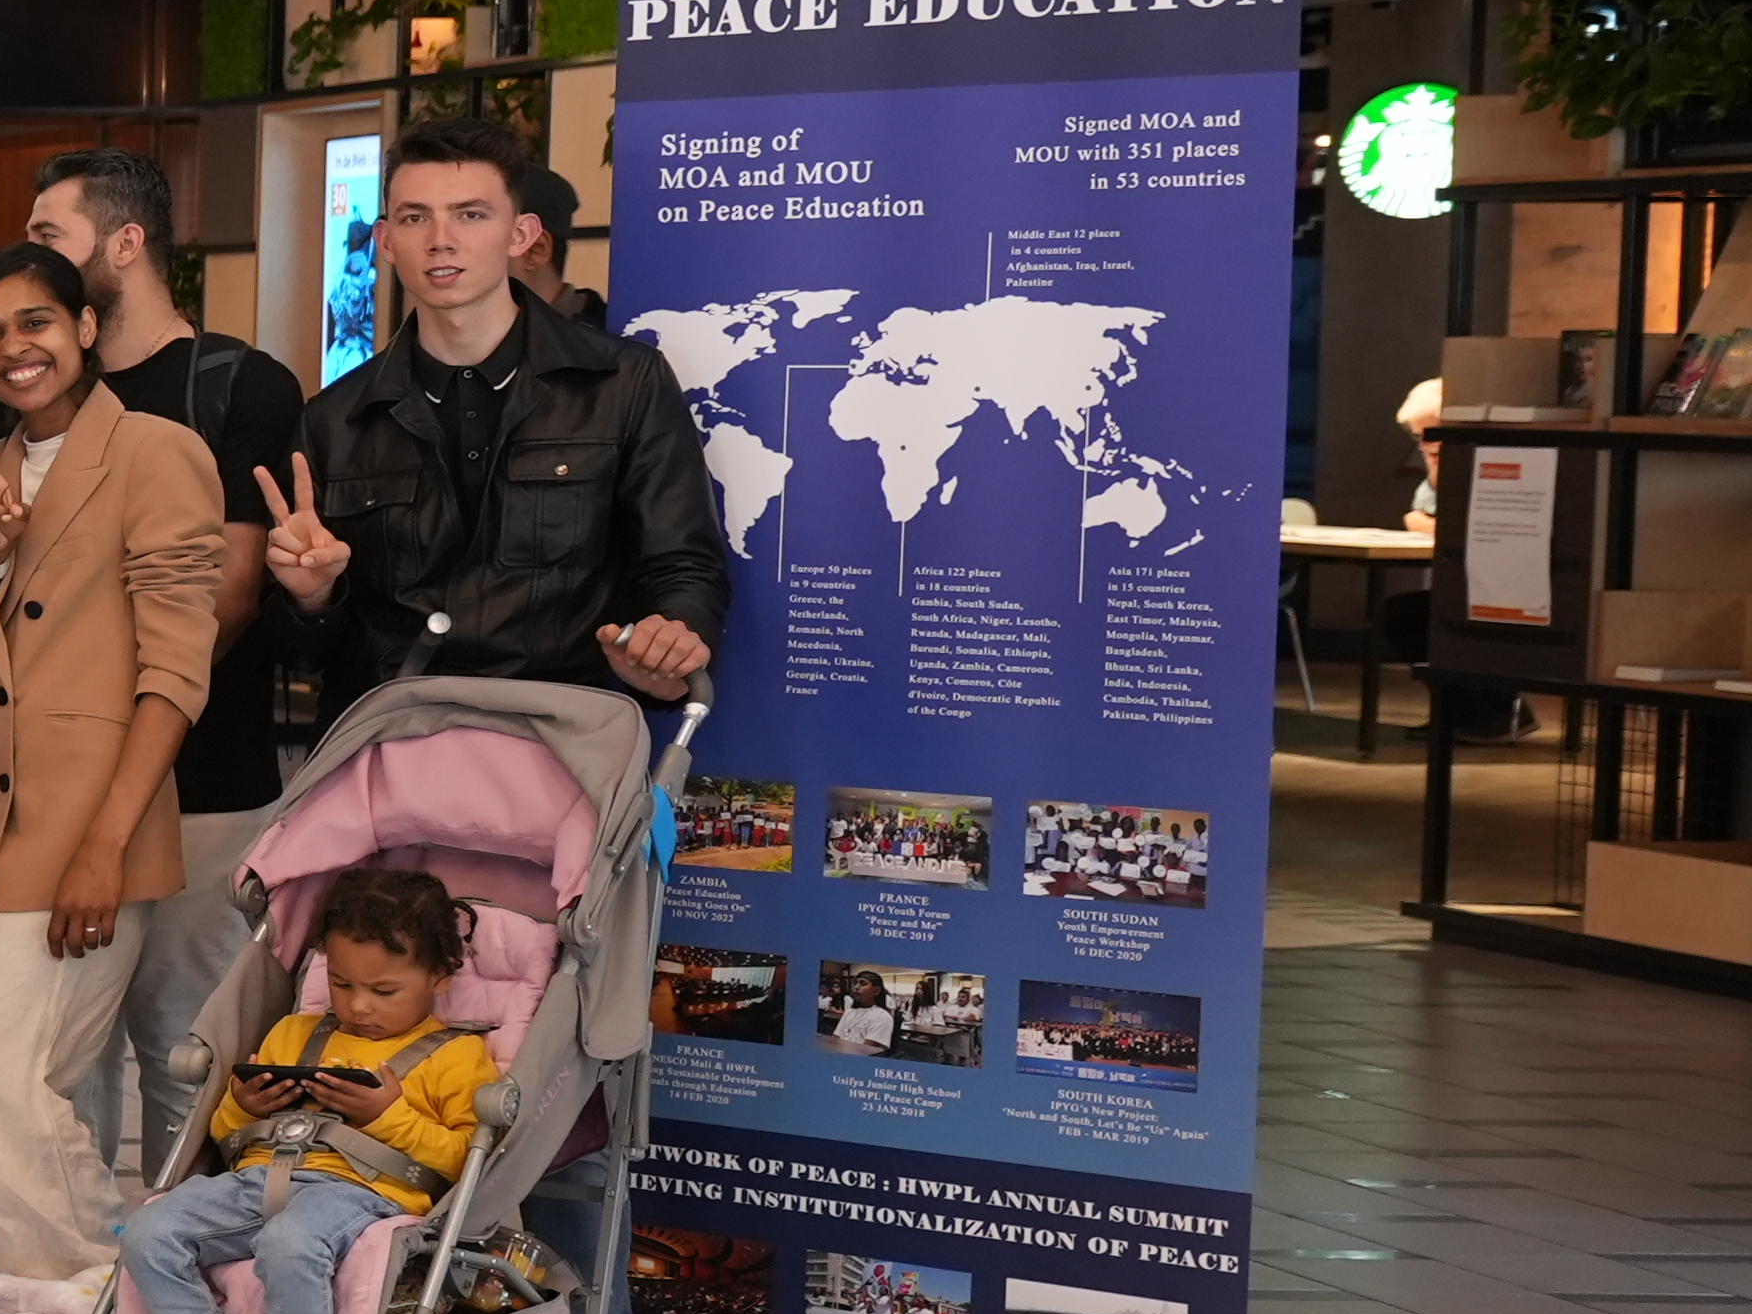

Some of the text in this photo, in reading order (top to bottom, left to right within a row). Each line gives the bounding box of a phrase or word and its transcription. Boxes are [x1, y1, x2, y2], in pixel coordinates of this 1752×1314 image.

[1065, 110, 1240, 136] Signed MOA and
[662, 128, 803, 160] Signing of
[1015, 141, 1239, 163] MOU with 351 places
[659, 161, 872, 189] MOA and MOU
[1091, 170, 1245, 189] in 53 countries
[658, 194, 924, 222] on Peace Education
[1089, 229, 1120, 239] places
[791, 564, 824, 575] Europe
[843, 566, 871, 576] places
[681, 876, 727, 888] ZAMBIA
[880, 893, 929, 905] FRANCE
[1064, 909, 1158, 926] SOUTH SUDAN
[647, 1144, 741, 1171] TWORK
[749, 1158, 783, 1175] OF
[791, 1163, 875, 1189] PEACE
[898, 1177, 980, 1203] HWPL
[986, 1190, 1101, 1219] ANNUAL
[1109, 1206, 1228, 1236] SUMMIT
[629, 1172, 1238, 1273] IEVING INSTITUTIONALIZATION OF PEACE
